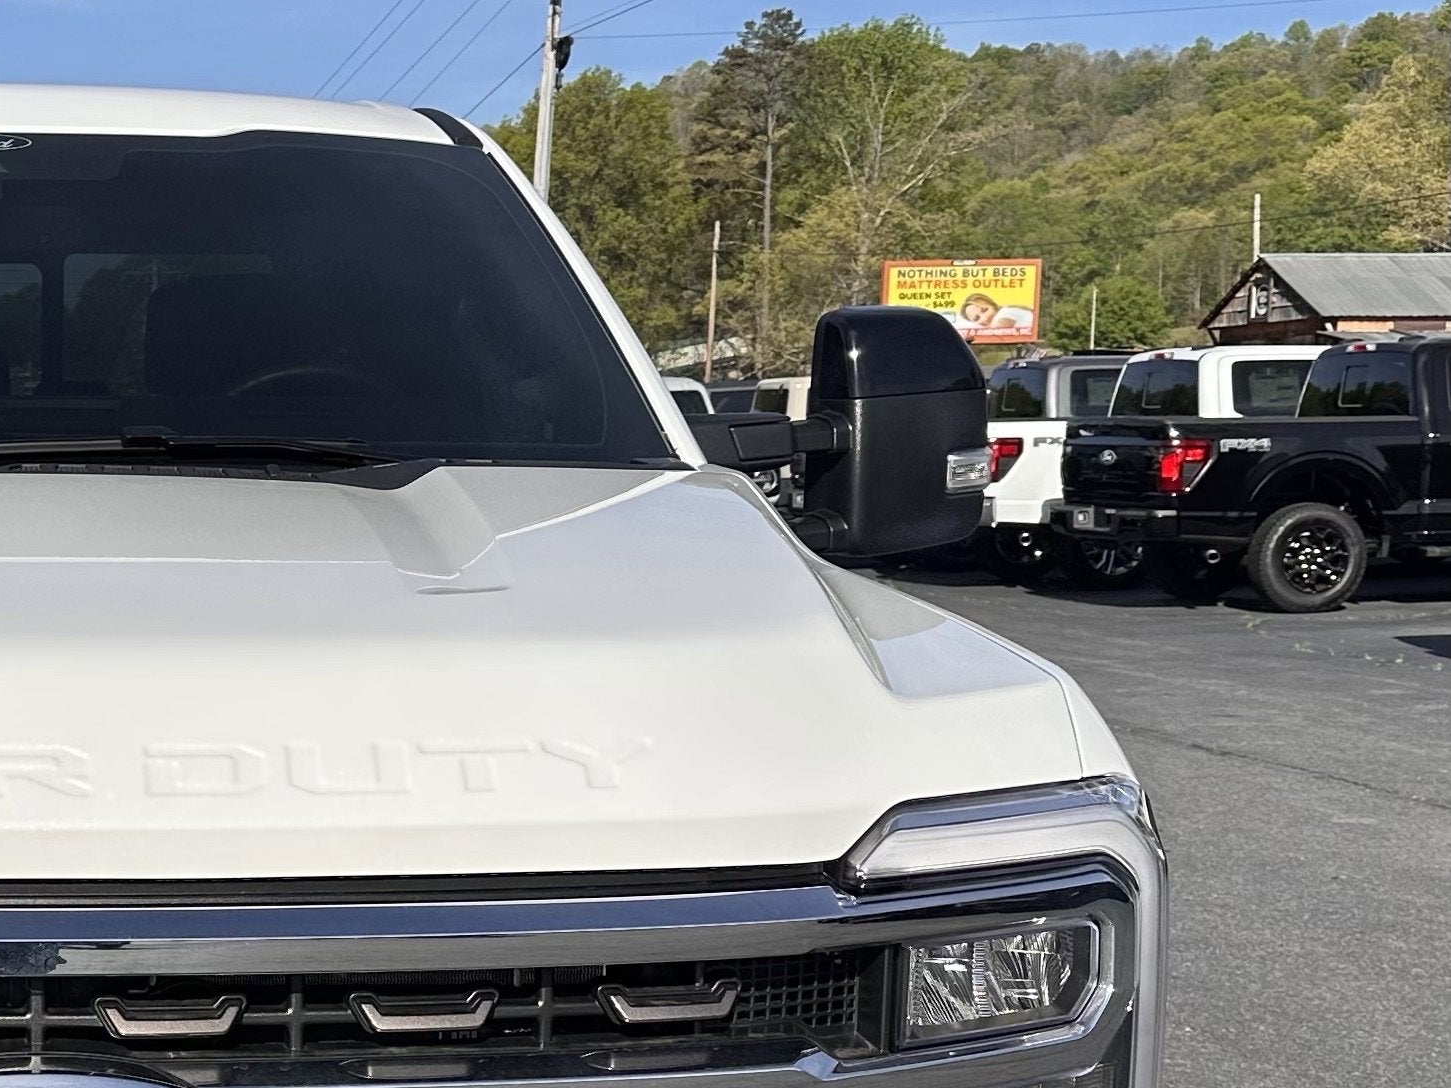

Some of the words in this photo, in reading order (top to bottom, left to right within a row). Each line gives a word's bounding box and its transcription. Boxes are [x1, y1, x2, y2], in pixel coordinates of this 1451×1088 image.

[897, 268, 957, 278] NOTHING
[962, 268, 988, 278] BUT
[992, 267, 1027, 277] BEDS
[897, 279, 968, 290] MATTRESS
[972, 278, 1026, 289] OUTLET
[898, 292, 932, 300] QUEEN
[934, 291, 952, 299] SET
[1219, 437, 1272, 453] FX4
[141, 734, 656, 797] DUTY
